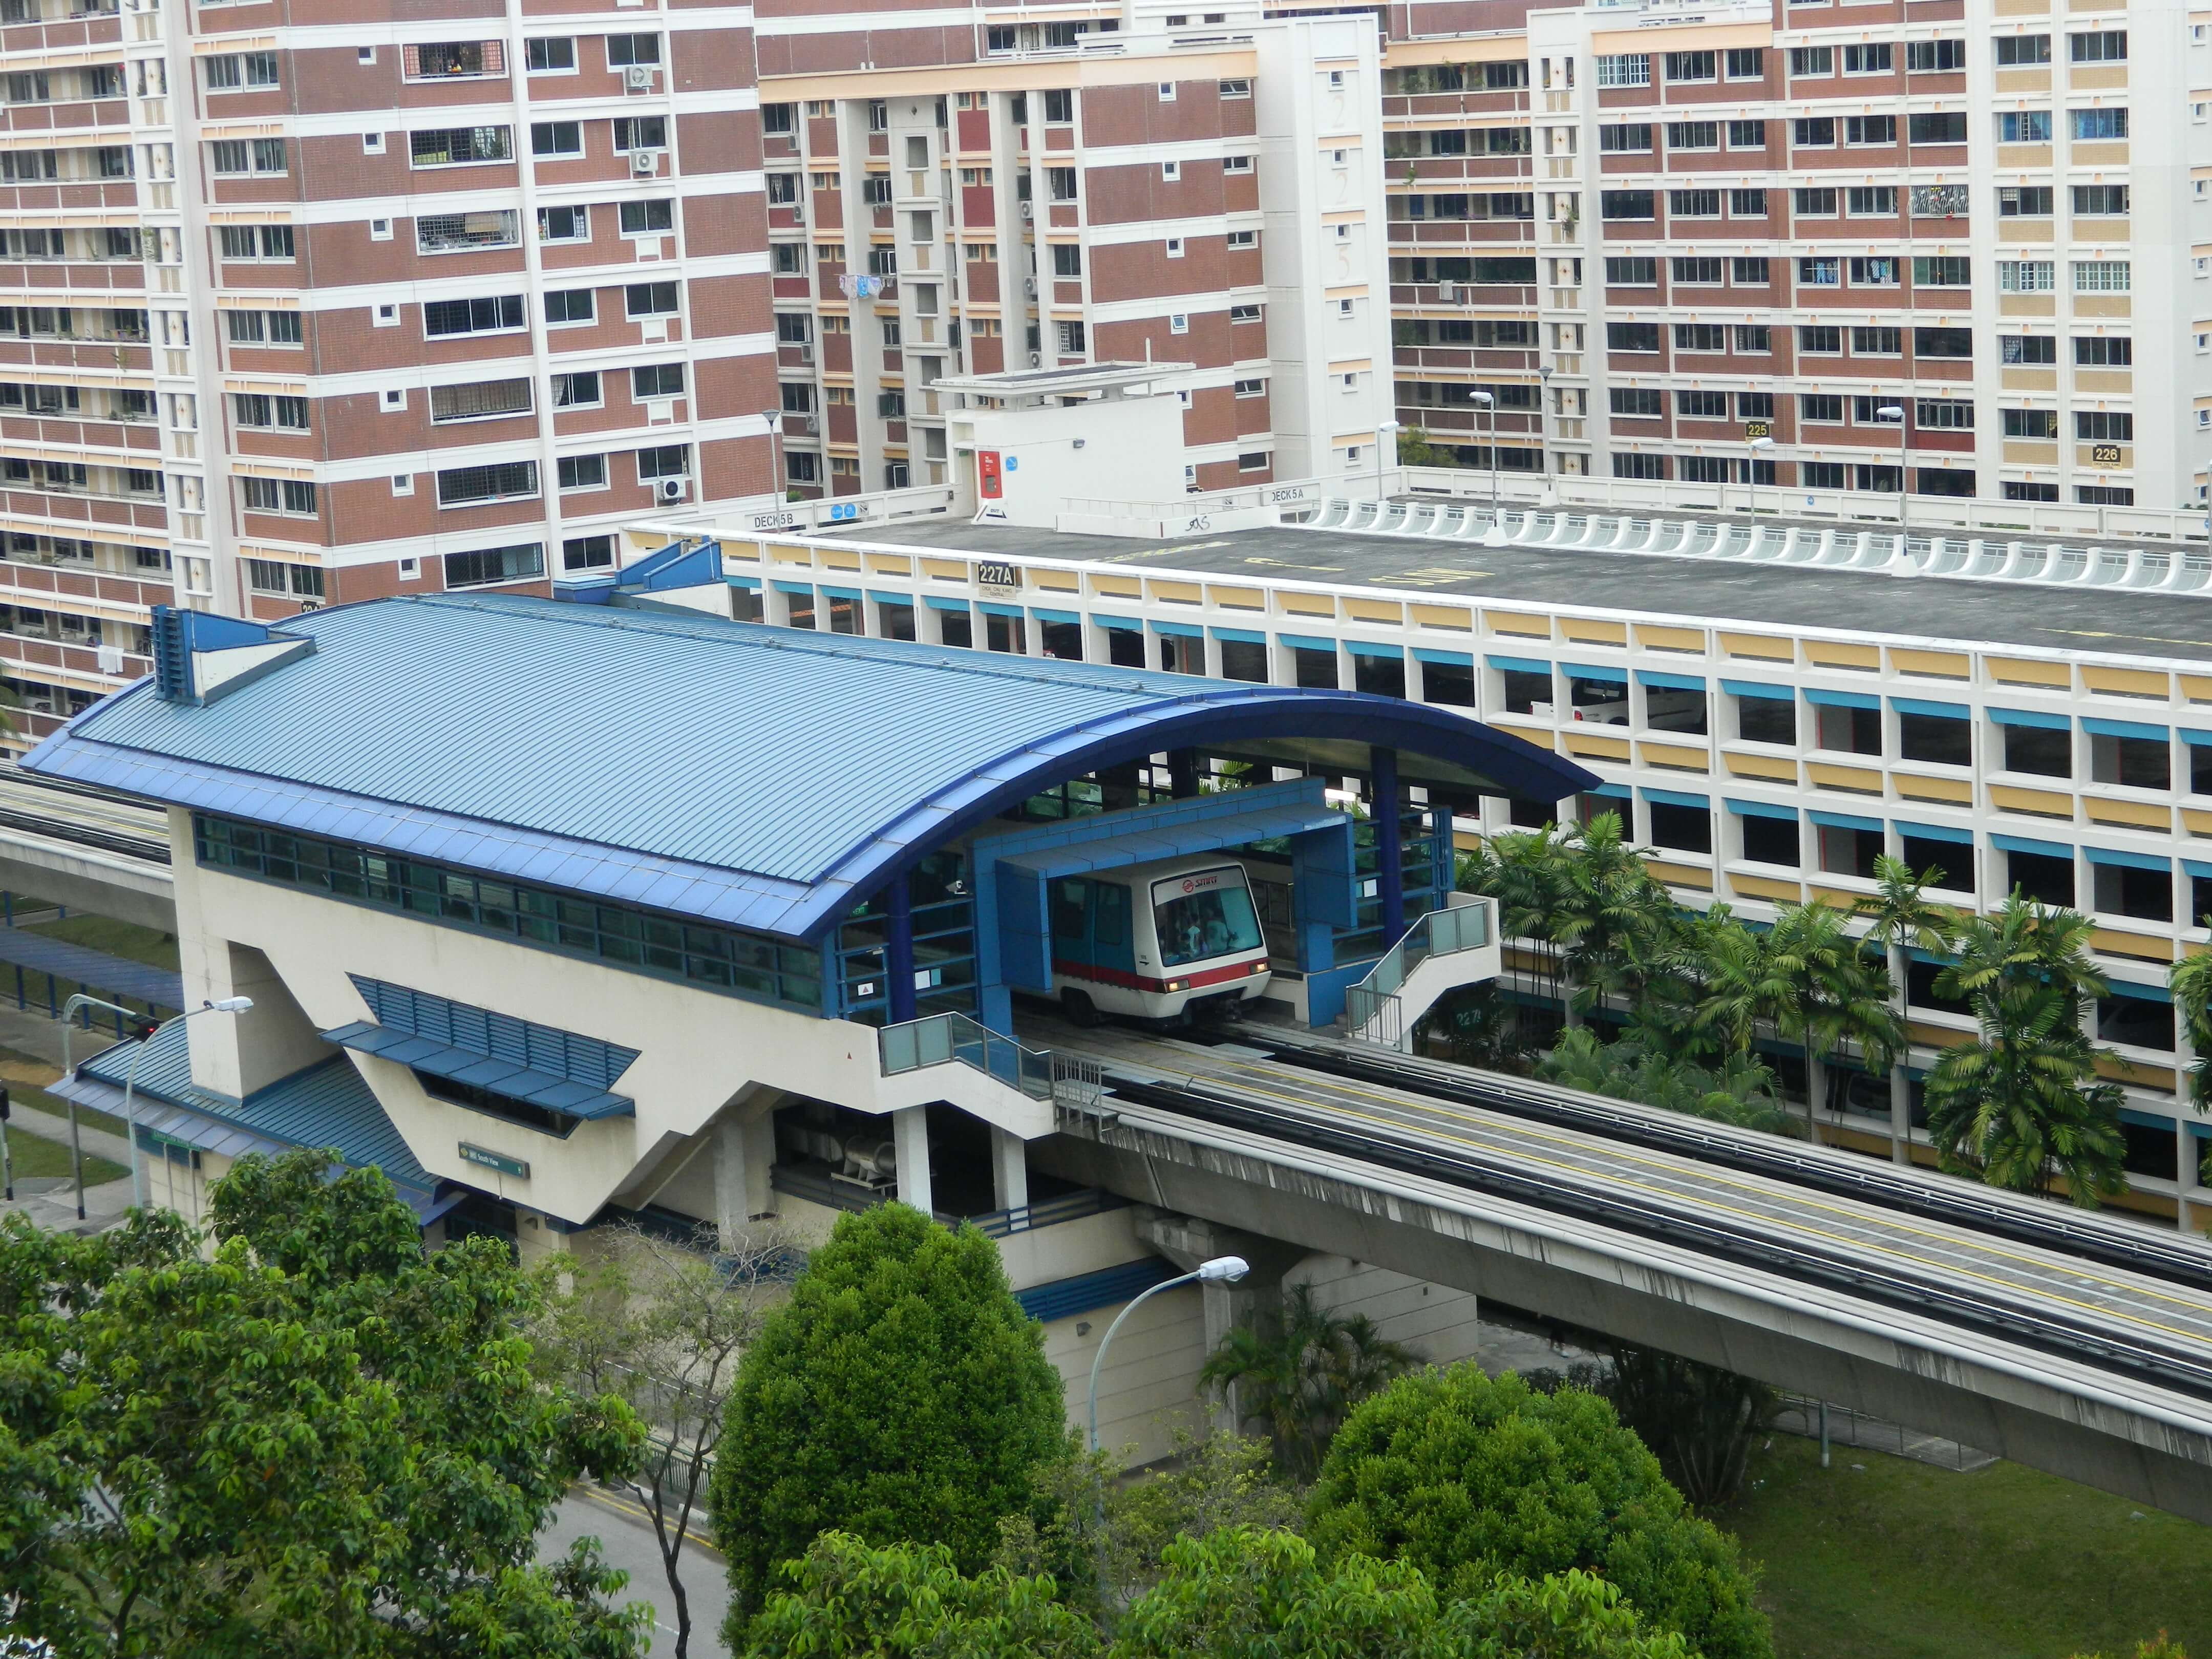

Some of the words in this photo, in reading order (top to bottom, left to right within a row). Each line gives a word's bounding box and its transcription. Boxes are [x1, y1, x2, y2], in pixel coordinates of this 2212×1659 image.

[1749, 424, 1767, 435] 225
[2096, 448, 2117, 460] 226
[1292, 489, 1297, 499] 5
[1298, 488, 1303, 498] A
[755, 515, 779, 528] DECK
[780, 514, 786, 525] 5
[787, 514, 794, 524] B
[980, 565, 1012, 584] 227A
[477, 1153, 489, 1163] South
[488, 1157, 499, 1166] View
